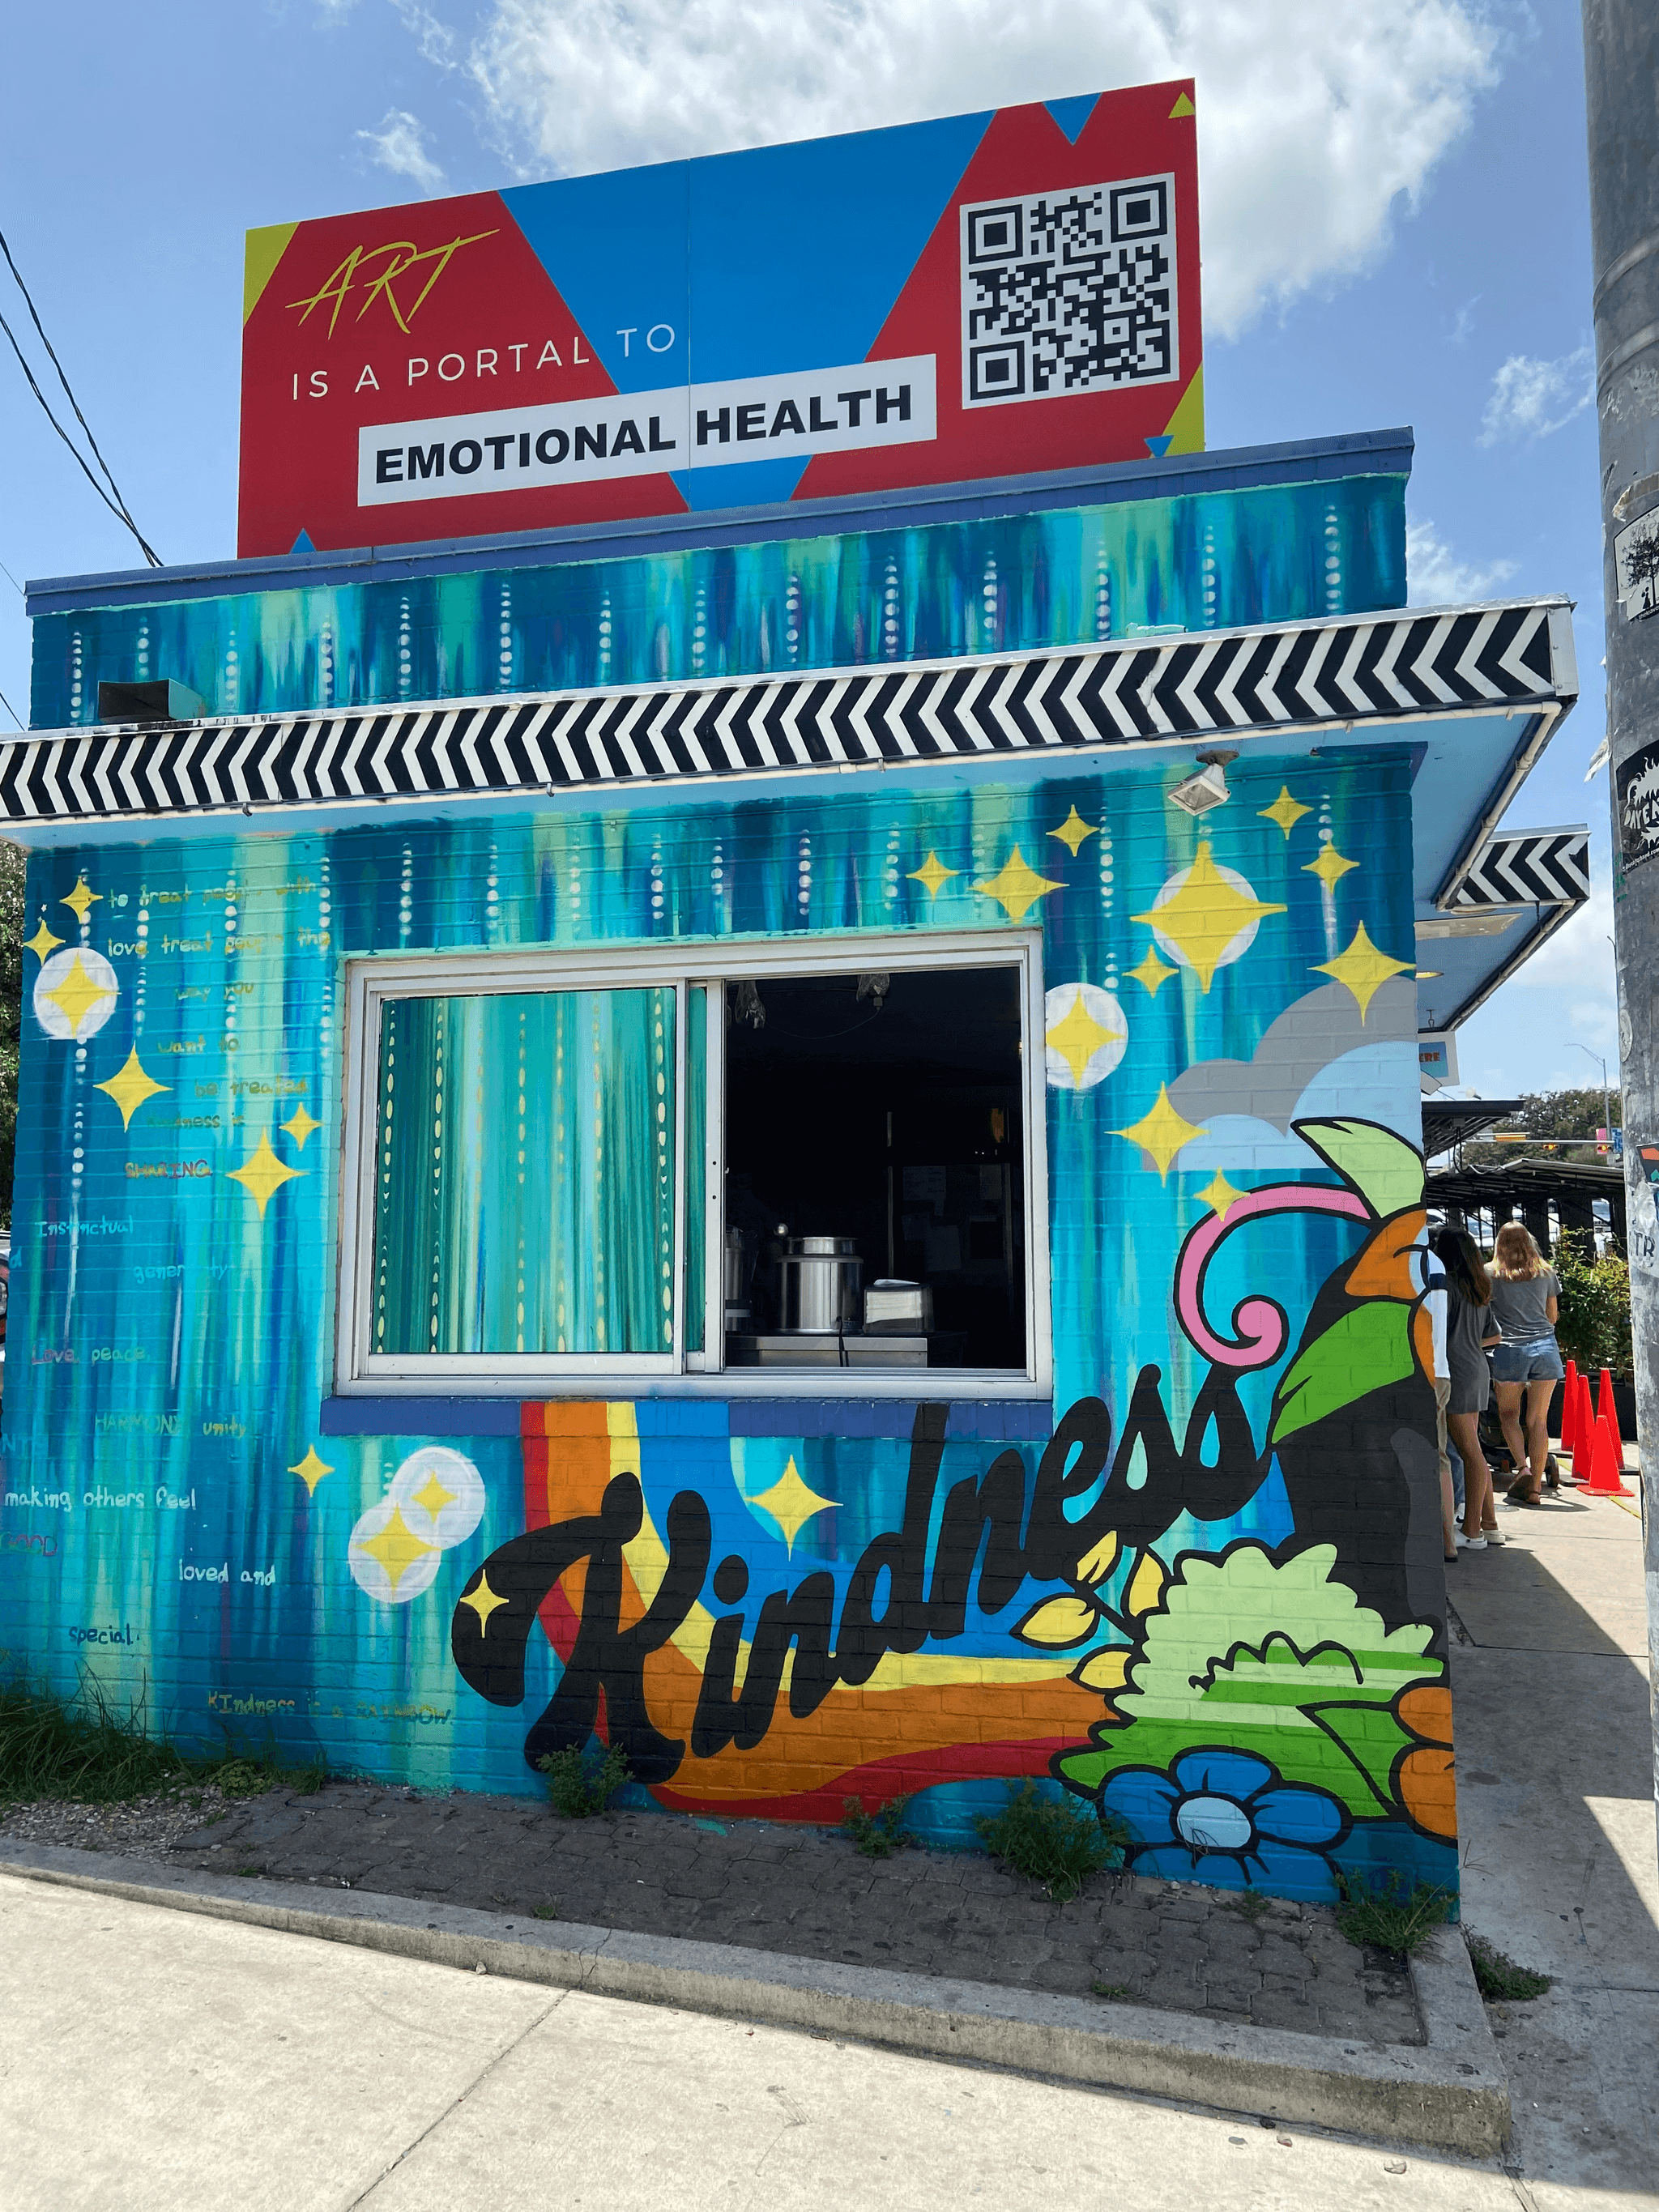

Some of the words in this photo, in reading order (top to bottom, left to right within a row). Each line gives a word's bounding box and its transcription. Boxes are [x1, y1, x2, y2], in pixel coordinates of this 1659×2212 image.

[285, 229, 501, 341] ART
[292, 370, 329, 401] IS
[355, 364, 380, 394] A
[408, 335, 590, 386] PORTAL
[616, 323, 676, 357] TO
[375, 416, 676, 484] EMOTIONAL
[697, 384, 911, 446] HEALTH
[108, 889, 128, 909] to
[139, 883, 193, 906] treat
[108, 937, 148, 957] love
[161, 930, 214, 955] treat
[224, 982, 254, 999] you
[125, 1158, 214, 1179] SHARING
[203, 1413, 247, 1440] unity
[4, 1485, 72, 1513] making
[83, 1485, 145, 1508] others
[156, 1486, 197, 1511] feel
[179, 1559, 229, 1583] loved
[240, 1565, 276, 1586] and
[451, 1362, 1272, 1783] Kindness
